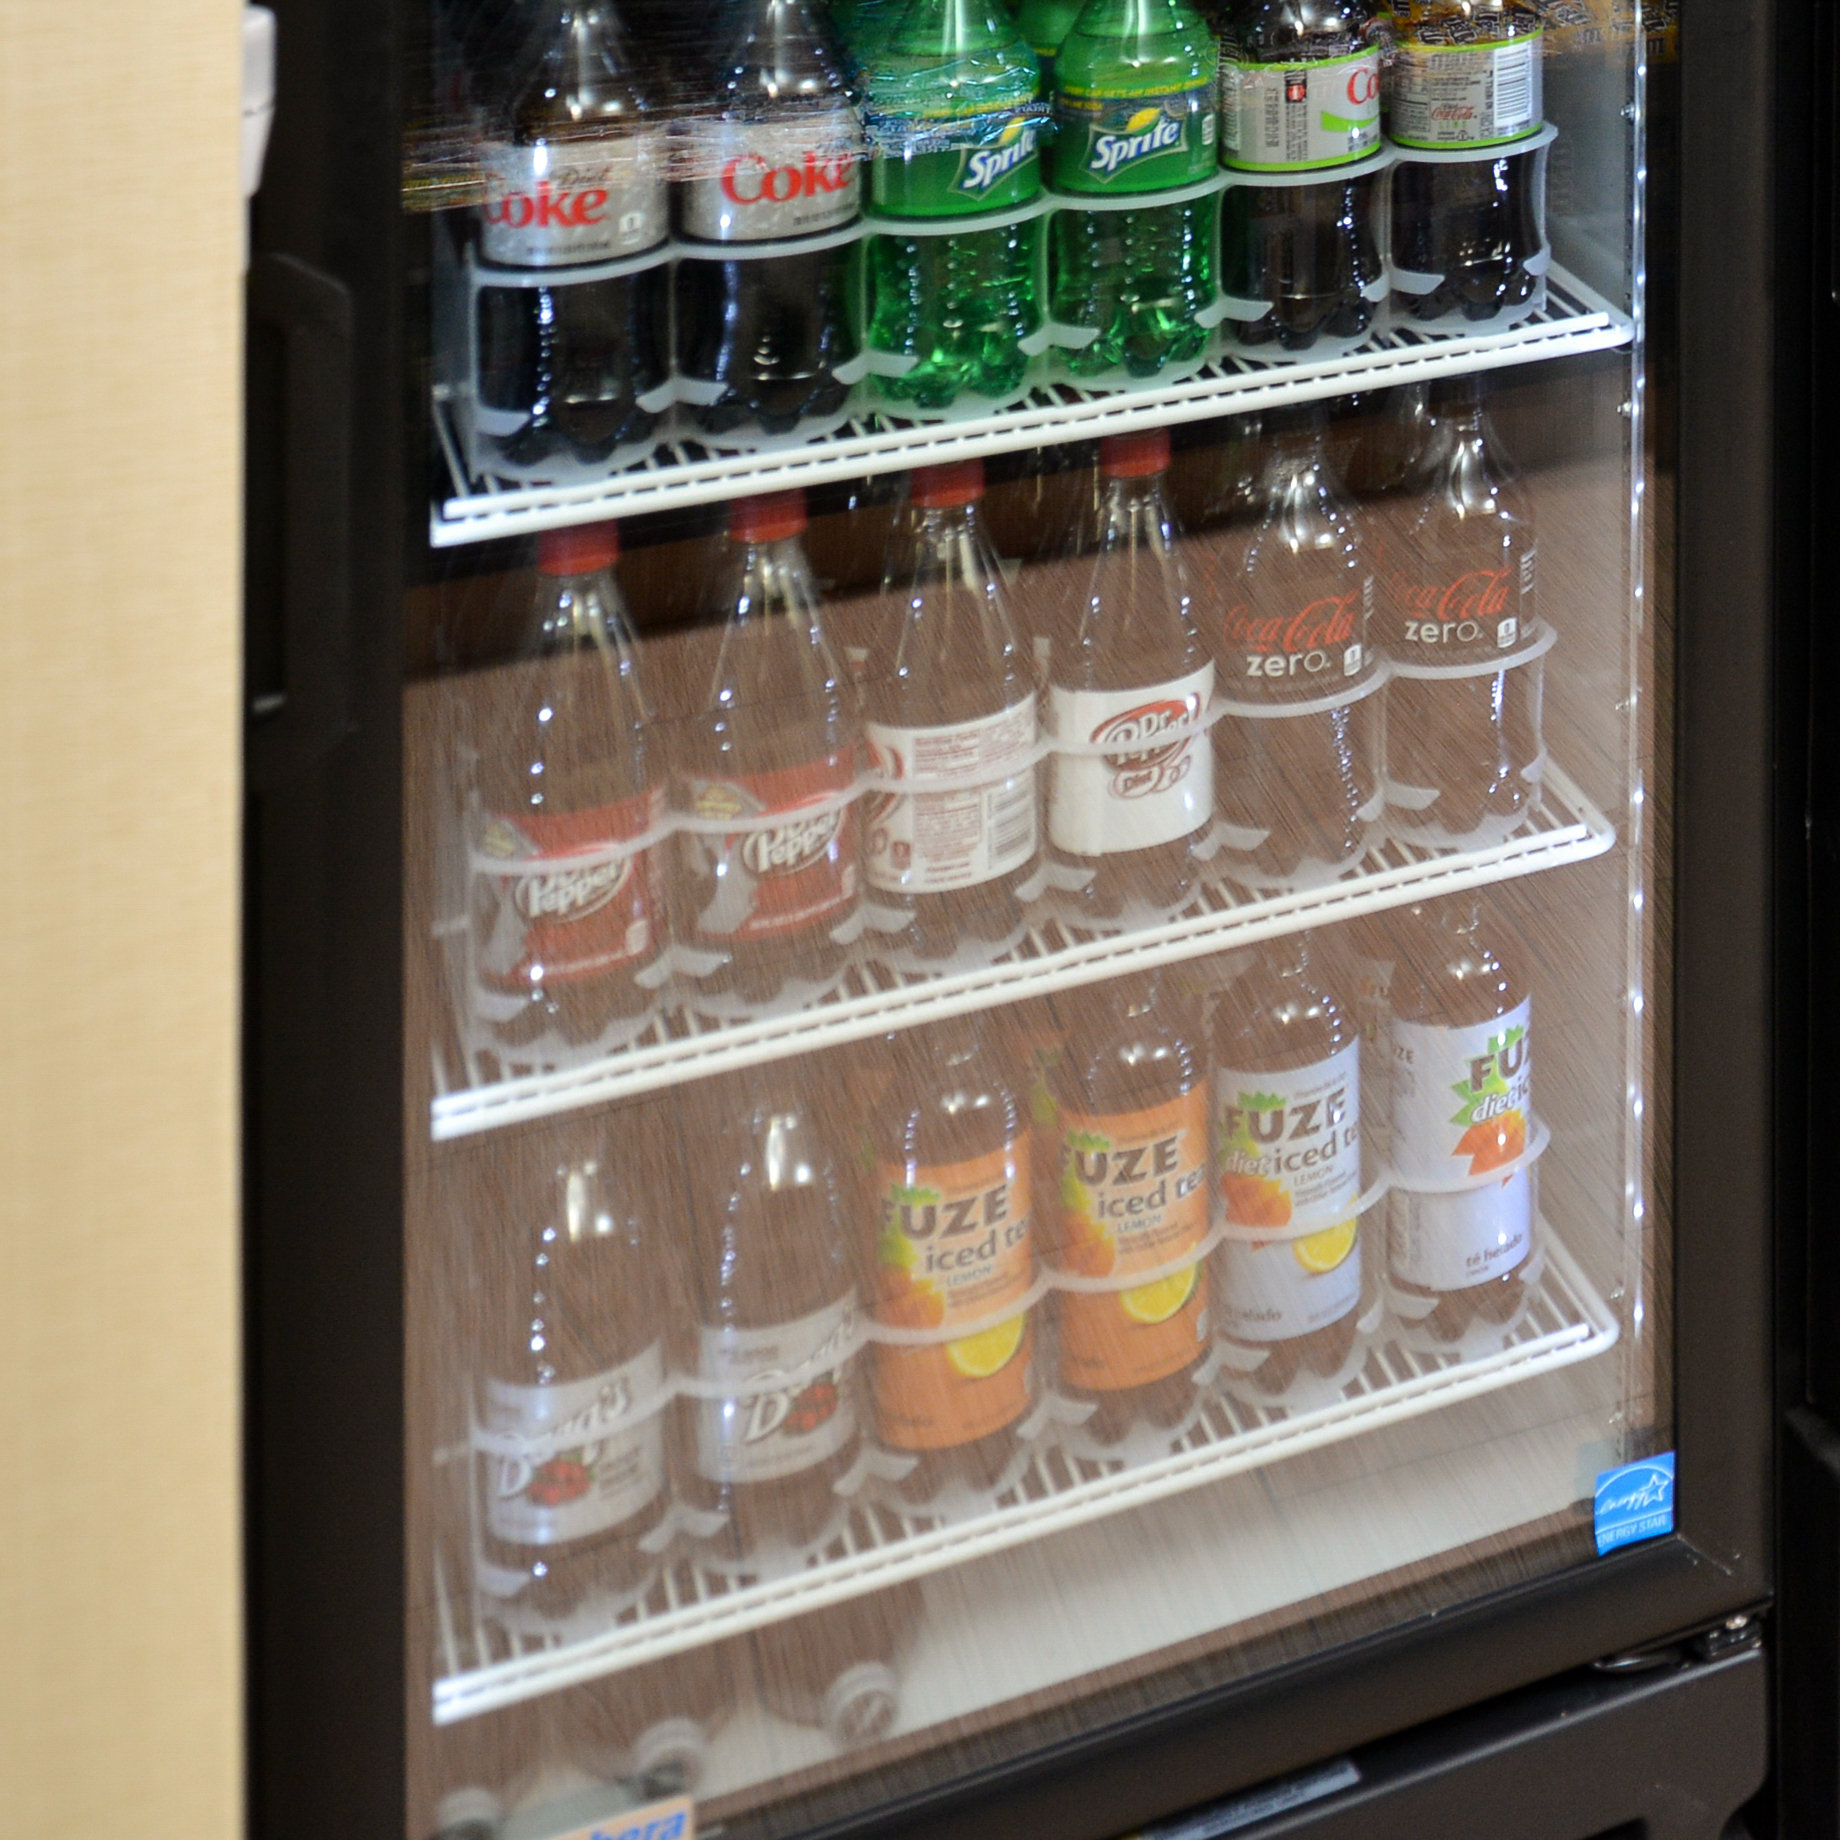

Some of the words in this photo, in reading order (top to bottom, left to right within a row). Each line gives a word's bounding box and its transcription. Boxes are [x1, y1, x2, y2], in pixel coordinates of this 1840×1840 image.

[1089, 115, 1184, 173] Sprite
[720, 149, 857, 206] Coke
[1221, 589, 1359, 654] Coca-Cola
[1403, 619, 1479, 645] zero
[1246, 650, 1327, 679] zero
[1224, 1086, 1349, 1145] FUZE
[1268, 1134, 1340, 1178] iced
[1293, 1164, 1335, 1187] LEMON
[880, 1180, 1011, 1243] FUZE
[1095, 1178, 1168, 1220] iced
[1116, 1214, 1162, 1233] LEMON
[924, 1234, 997, 1275] iced
[945, 1263, 994, 1289] LEMON
